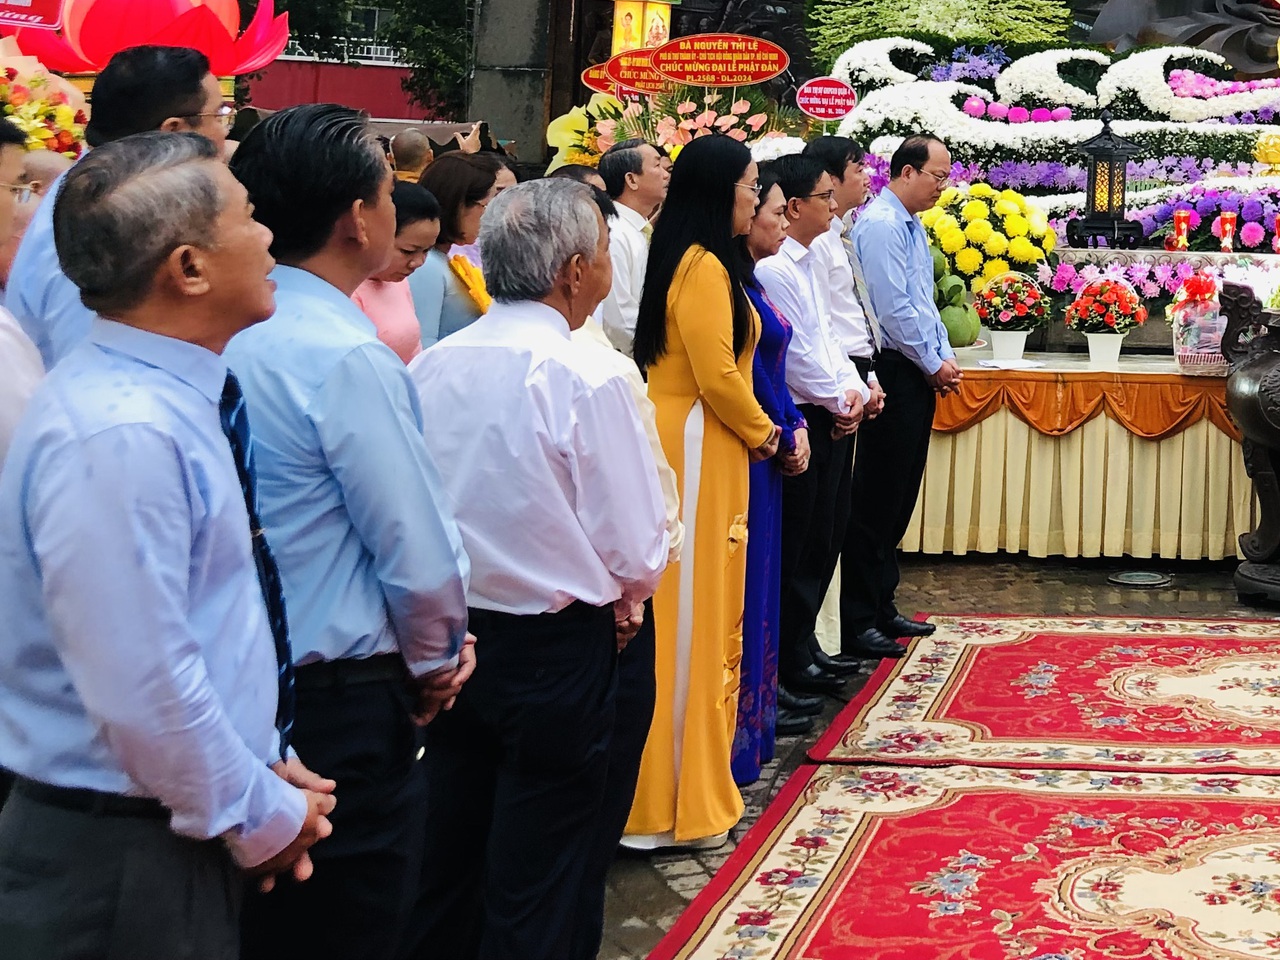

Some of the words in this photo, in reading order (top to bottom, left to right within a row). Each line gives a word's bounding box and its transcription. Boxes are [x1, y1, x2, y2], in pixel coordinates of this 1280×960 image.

[680, 40, 692, 50] BÀ
[694, 39, 729, 50] NGUYỄN
[660, 61, 683, 72] CHÚC
[684, 60, 710, 72] MỪNG
[712, 62, 726, 74] ĐẠI
[727, 59, 737, 72] LỄ
[738, 60, 760, 74] PHẬT
[761, 60, 779, 72] ĐẢN
